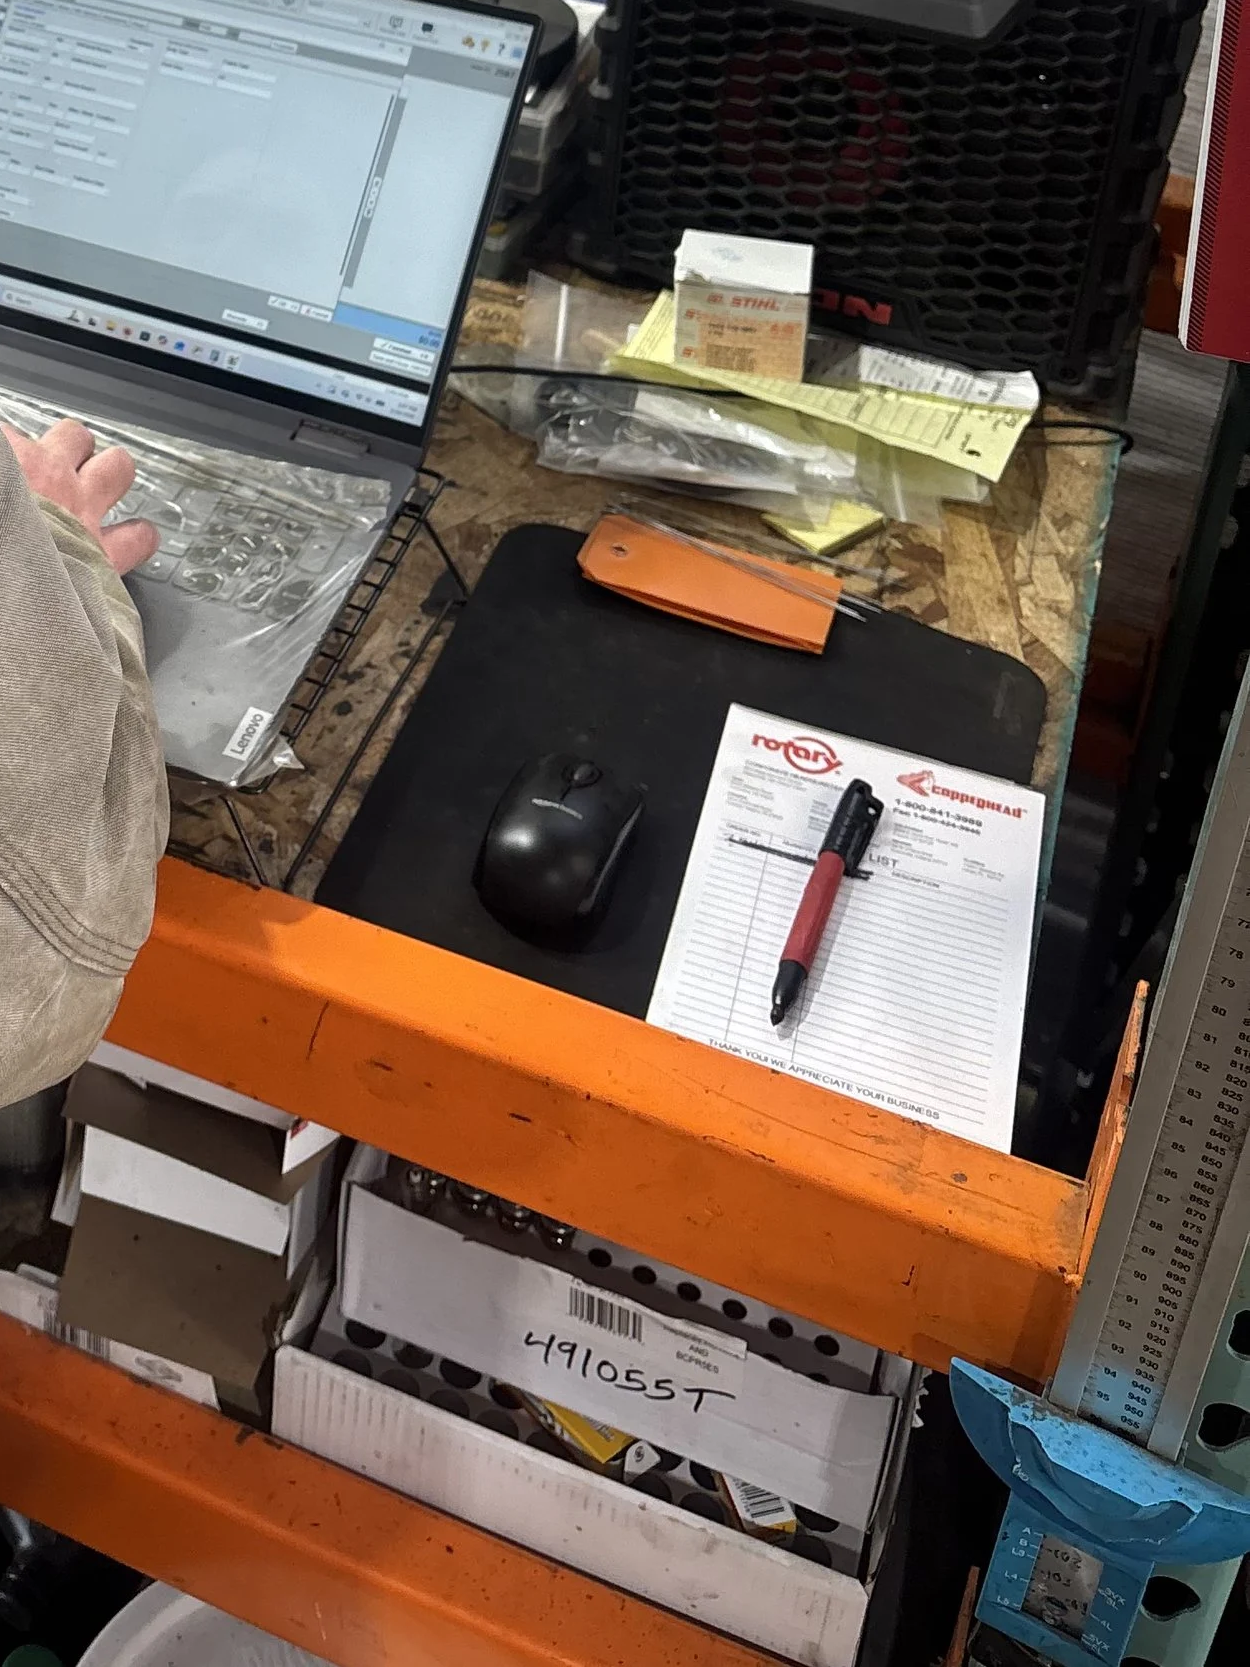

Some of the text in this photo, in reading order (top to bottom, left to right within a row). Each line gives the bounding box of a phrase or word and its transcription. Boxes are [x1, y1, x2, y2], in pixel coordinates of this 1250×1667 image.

[730, 295, 780, 311] STIHL
[230, 713, 264, 755] Lenovo
[751, 733, 844, 771] rotary
[868, 853, 899, 869] LIST
[1229, 947, 1244, 960] 78
[1220, 976, 1236, 988] 79
[1211, 1005, 1227, 1017] 80
[1203, 1033, 1217, 1044] 81
[1195, 1060, 1210, 1073] 82
[1230, 1059, 1250, 1074] 815
[709, 1038, 742, 1055] THANK
[771, 1057, 787, 1068] WE
[788, 1064, 855, 1092] APPRECIATE
[856, 1086, 885, 1103] YOUR
[886, 1095, 940, 1120] BUSINESS
[1225, 1074, 1248, 1088] 820
[1186, 1088, 1202, 1099] 83
[1221, 1087, 1244, 1102] 825
[1217, 1101, 1239, 1115] 830
[1179, 1115, 1193, 1126] 84
[1213, 1114, 1236, 1129] 835
[1209, 1128, 1231, 1143] 840
[1171, 1142, 1186, 1153] 85
[1205, 1141, 1226, 1156] 845
[1201, 1155, 1223, 1169] 850
[1163, 1167, 1178, 1179] 86
[1197, 1168, 1218, 1182] 855
[1193, 1181, 1214, 1195] 860
[1156, 1194, 1171, 1204] 87
[1189, 1194, 1211, 1208] 865
[1185, 1207, 1207, 1221] 870
[1149, 1220, 1163, 1231] 88
[1182, 1220, 1203, 1234] 875
[1178, 1233, 1199, 1248] 880
[1141, 1245, 1156, 1256] 89
[1174, 1245, 1195, 1260] 885
[1170, 1258, 1191, 1272] 890
[1133, 1270, 1147, 1282] 90
[1166, 1271, 1187, 1285] 895
[1162, 1283, 1182, 1297] 900
[1126, 1295, 1138, 1305] 91
[1158, 1296, 1178, 1310] 905
[1154, 1308, 1174, 1322] 910
[1150, 1320, 1170, 1334] 915
[1142, 1344, 1163, 1359] 925
[1139, 1356, 1159, 1370] 930
[524, 1331, 736, 1413] 491055T
[1135, 1368, 1155, 1382] 935
[1131, 1380, 1151, 1394] 940
[1096, 1390, 1110, 1402] 95
[1127, 1392, 1147, 1406] 945
[1124, 1403, 1144, 1418] 950
[1022, 1527, 1031, 1535] A
